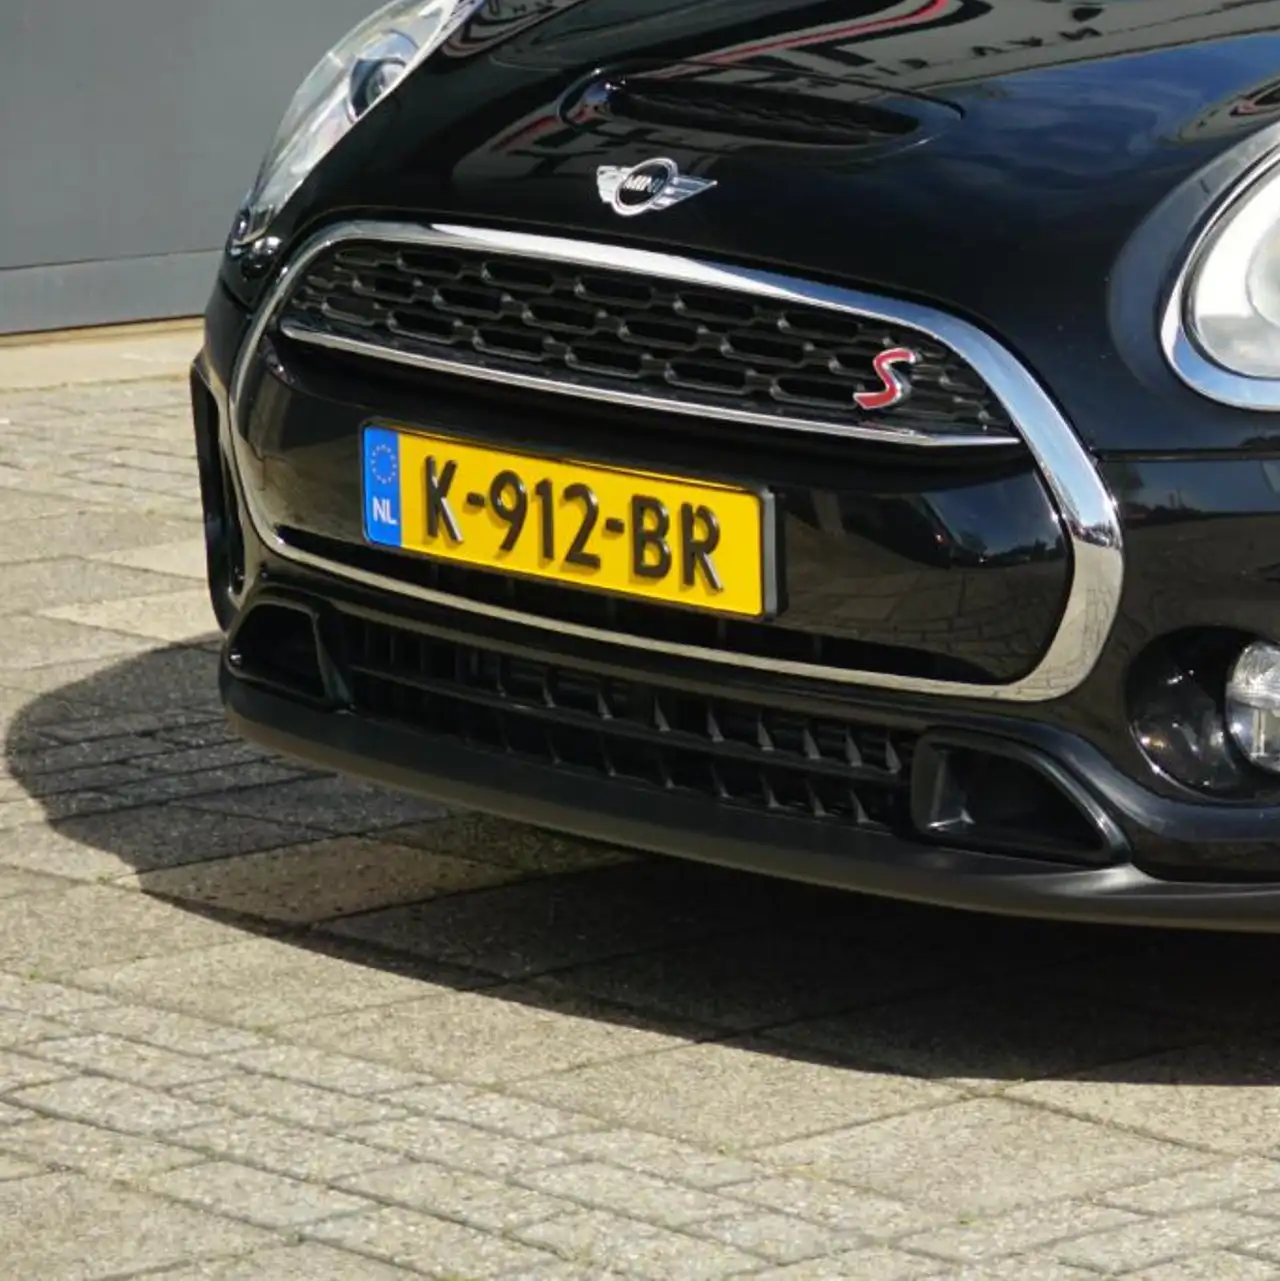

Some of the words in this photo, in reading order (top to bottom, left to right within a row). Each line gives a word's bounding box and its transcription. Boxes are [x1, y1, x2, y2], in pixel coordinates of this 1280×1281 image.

[622, 173, 664, 193] MINI
[853, 348, 914, 410] S
[372, 498, 398, 526] NL
[424, 455, 725, 594] K-912-BR
